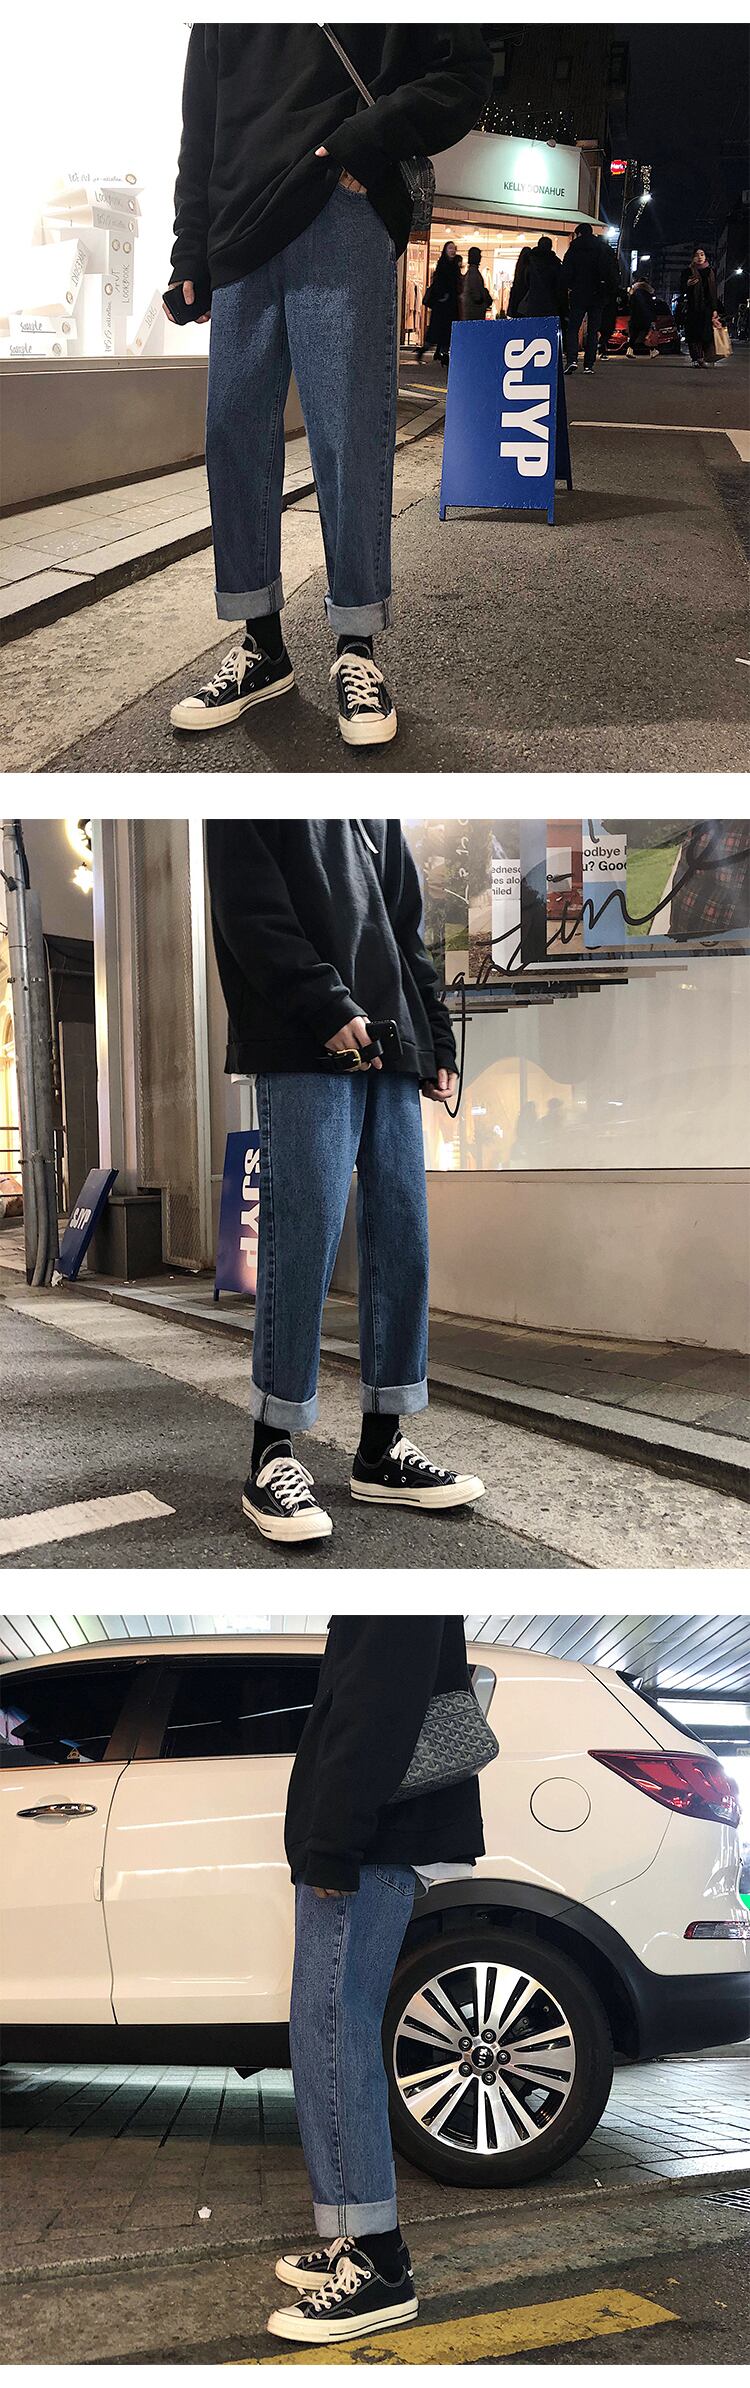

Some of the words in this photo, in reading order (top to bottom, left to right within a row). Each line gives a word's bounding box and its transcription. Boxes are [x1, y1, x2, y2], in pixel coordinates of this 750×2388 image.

[503, 181, 525, 192] KELLY
[527, 184, 565, 197] DONAHUE
[500, 338, 552, 477] SJYP
[69, 1207, 92, 1230] SJYP
[240, 1148, 261, 1268] SJYP
